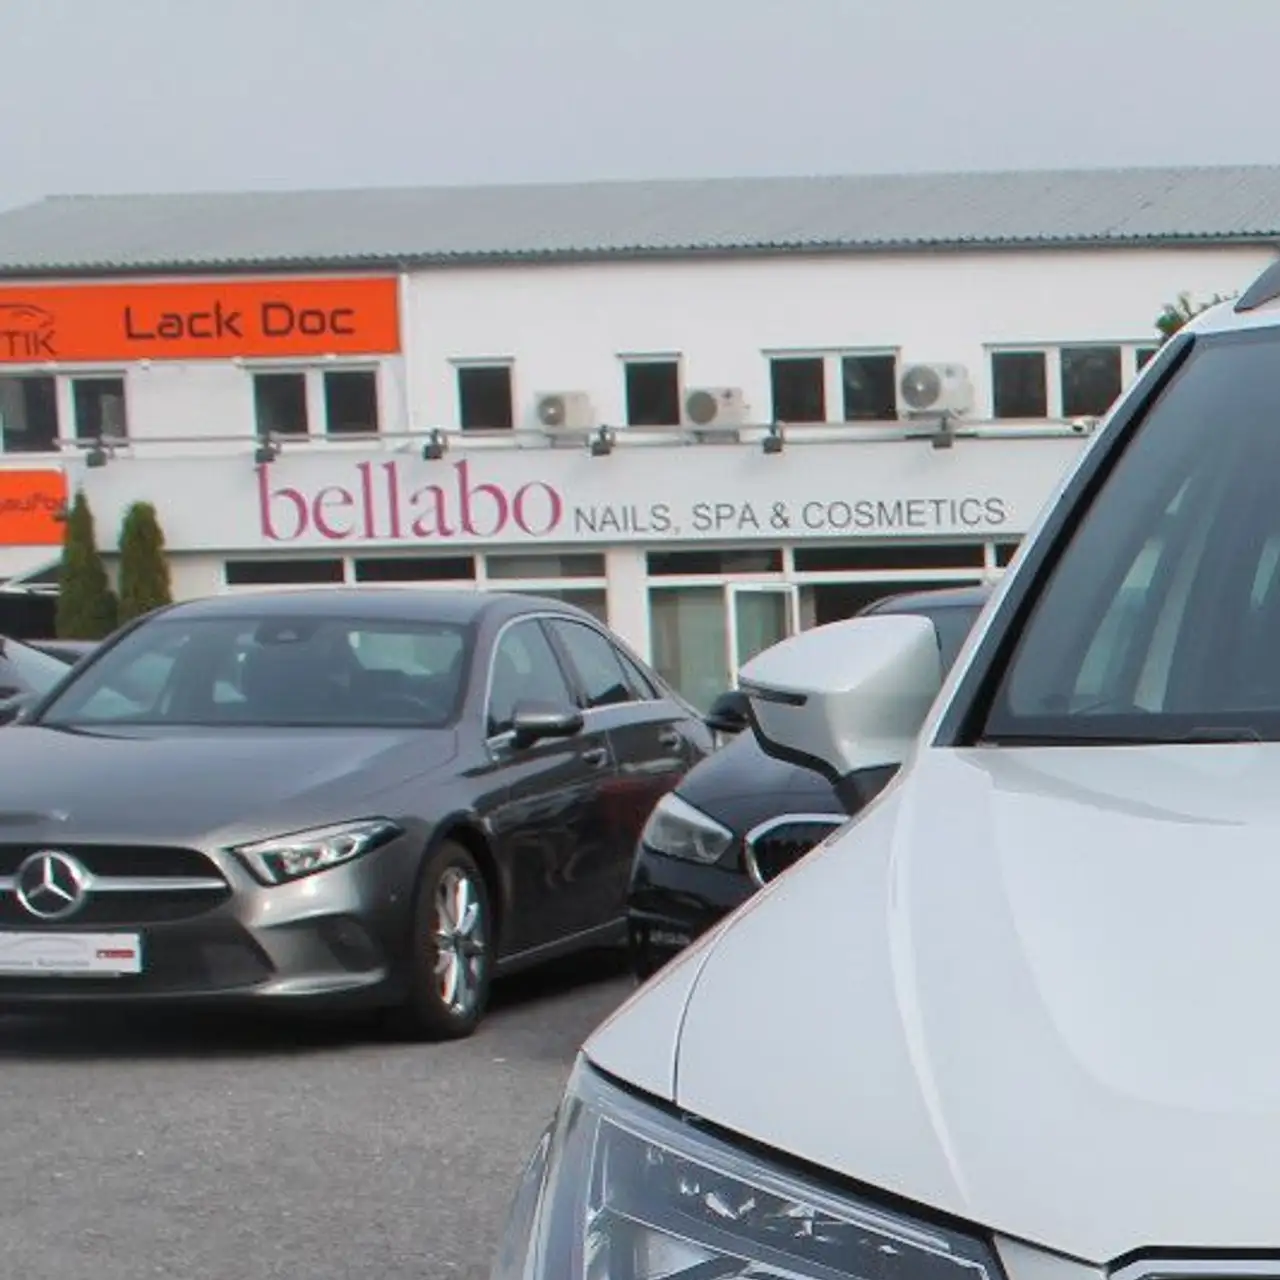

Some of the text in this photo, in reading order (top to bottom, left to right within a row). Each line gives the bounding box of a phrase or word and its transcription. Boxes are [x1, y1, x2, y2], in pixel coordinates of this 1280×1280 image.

[124, 300, 356, 340] Lack Doc
[255, 459, 1006, 541] bellabo NAILS, SPA & COSMETICS
